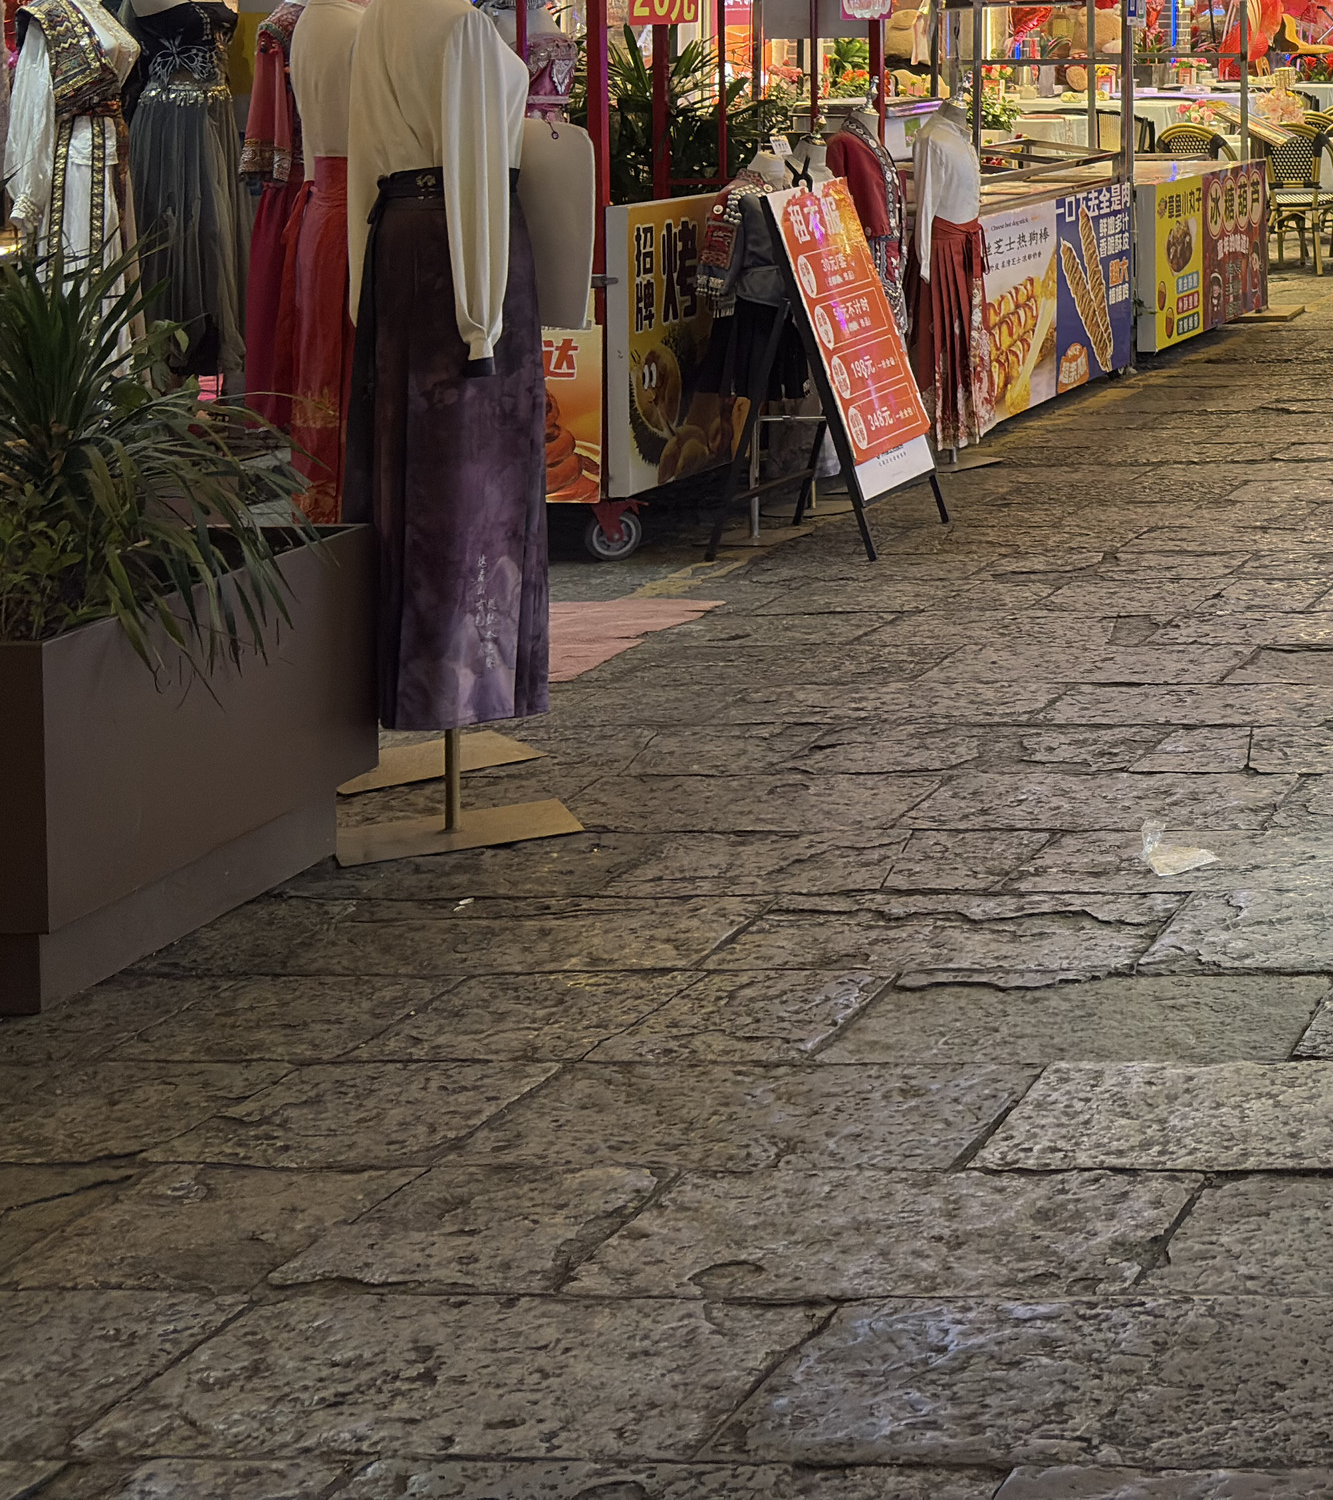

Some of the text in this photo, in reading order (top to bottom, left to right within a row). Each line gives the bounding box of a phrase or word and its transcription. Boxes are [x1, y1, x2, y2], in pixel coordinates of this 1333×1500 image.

[1055, 181, 1131, 223] 一口下去全是肉
[1166, 186, 1202, 219] 章鱼小丸子
[1210, 179, 1261, 226] 冰糖葫芦
[788, 195, 843, 244] 租衣服
[1099, 211, 1130, 238] 鲜嫩多汁
[1099, 232, 1130, 258] 香脆酥皮
[634, 217, 699, 334] 招牌 烤
[832, 297, 870, 323] 5元不计时
[849, 355, 877, 379] 198元
[866, 407, 894, 432] 348元
